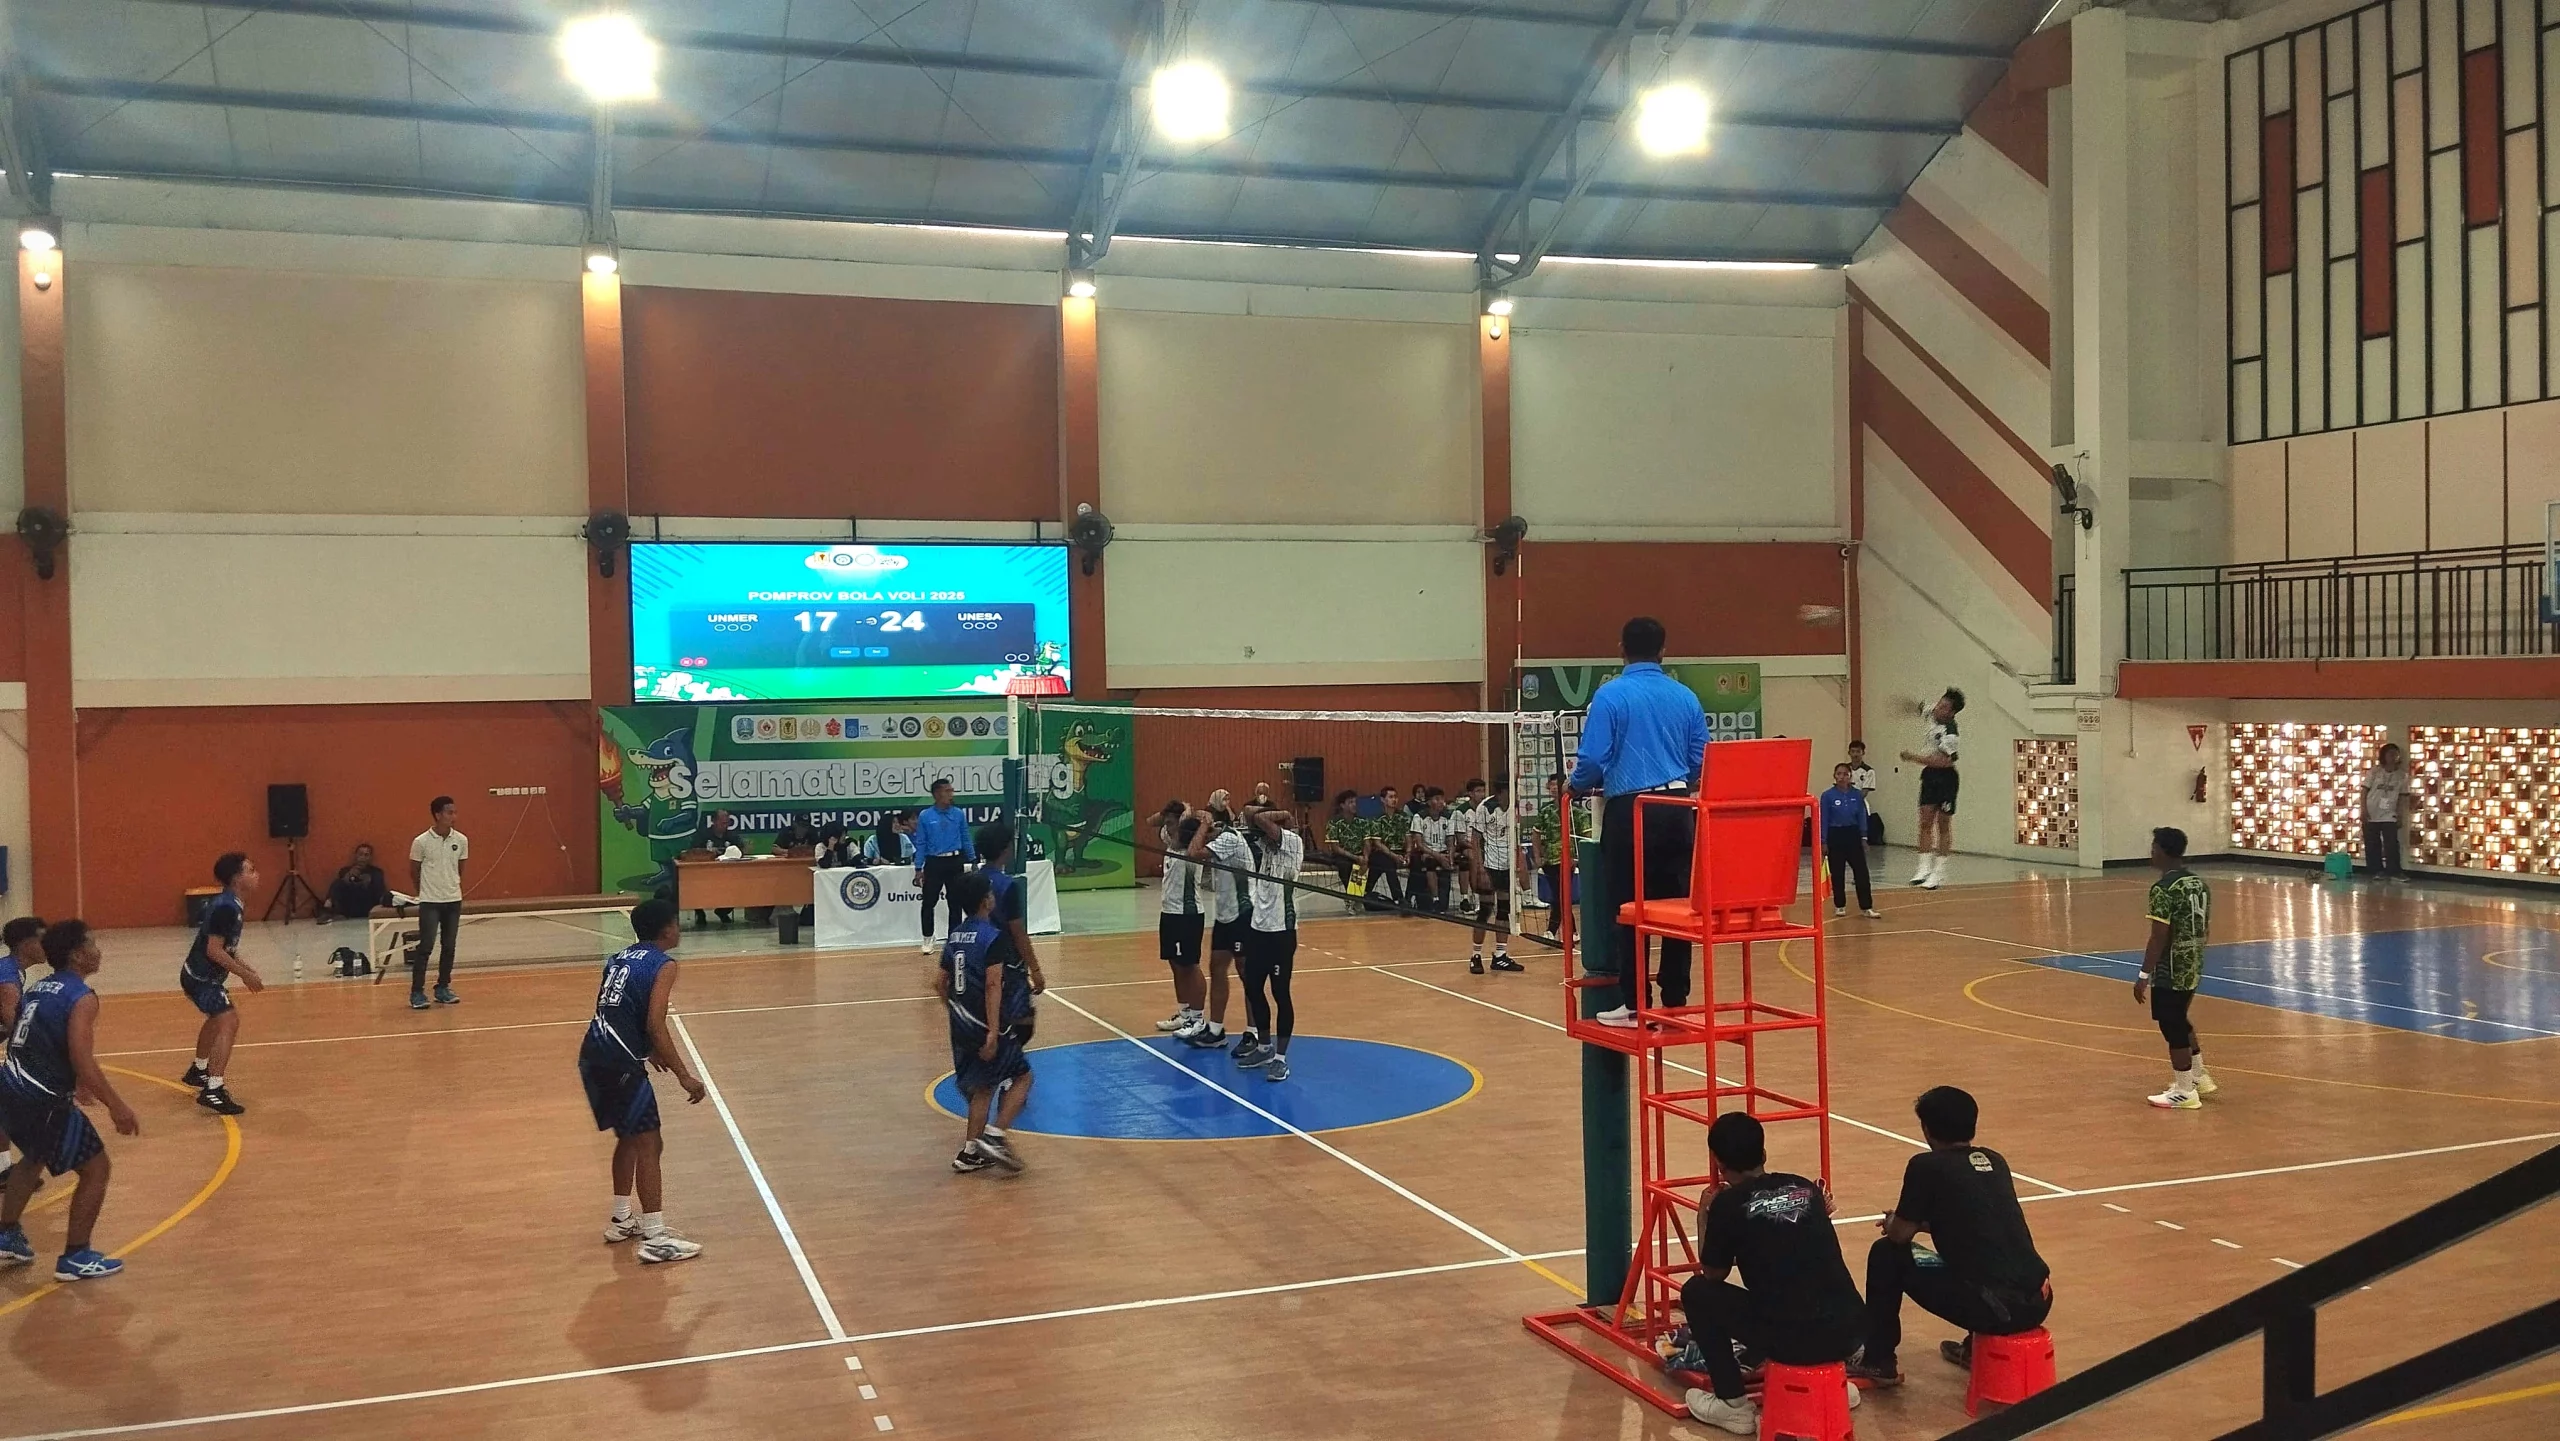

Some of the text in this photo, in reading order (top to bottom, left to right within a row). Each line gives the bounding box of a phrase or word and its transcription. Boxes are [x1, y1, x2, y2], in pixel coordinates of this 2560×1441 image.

[748, 591, 965, 601] POMPROV BOLA VOLI 2025
[707, 613, 759, 623] UNMER
[794, 611, 838, 632] 17
[880, 611, 925, 632] 24
[957, 612, 1003, 622] UNESA
[668, 763, 847, 800] Selamat
[1033, 843, 1043, 855] 24
[1175, 942, 1182, 956] 1
[1234, 941, 1241, 952] 9
[1274, 965, 1280, 976] 3
